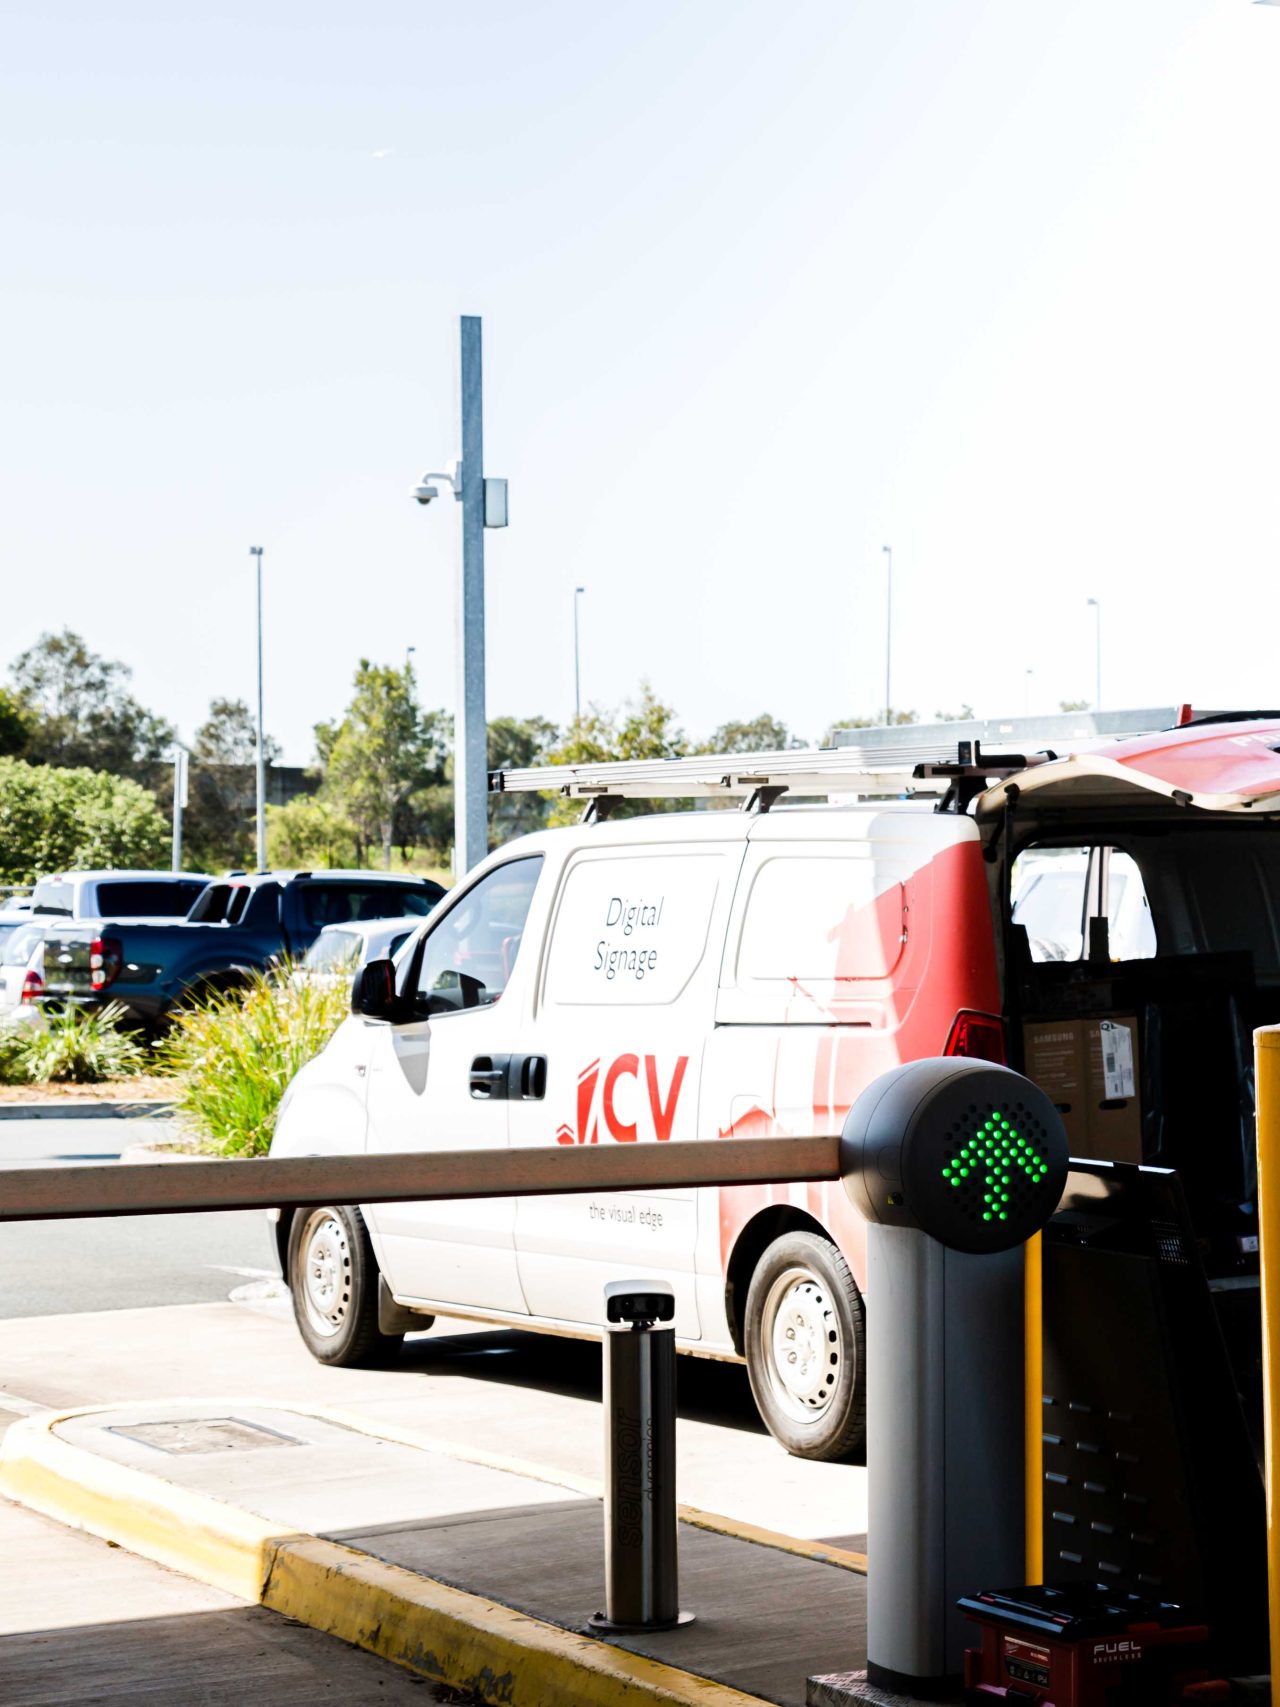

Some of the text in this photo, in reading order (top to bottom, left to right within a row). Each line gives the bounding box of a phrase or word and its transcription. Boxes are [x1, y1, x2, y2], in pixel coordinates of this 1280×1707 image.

[607, 895, 664, 935] Digital
[593, 939, 658, 979] Signage
[1034, 1032, 1073, 1043] SAMSUNG
[590, 1202, 663, 1231] the visual edge
[617, 1408, 642, 1548] sensor
[1094, 1641, 1142, 1654] FUEL
